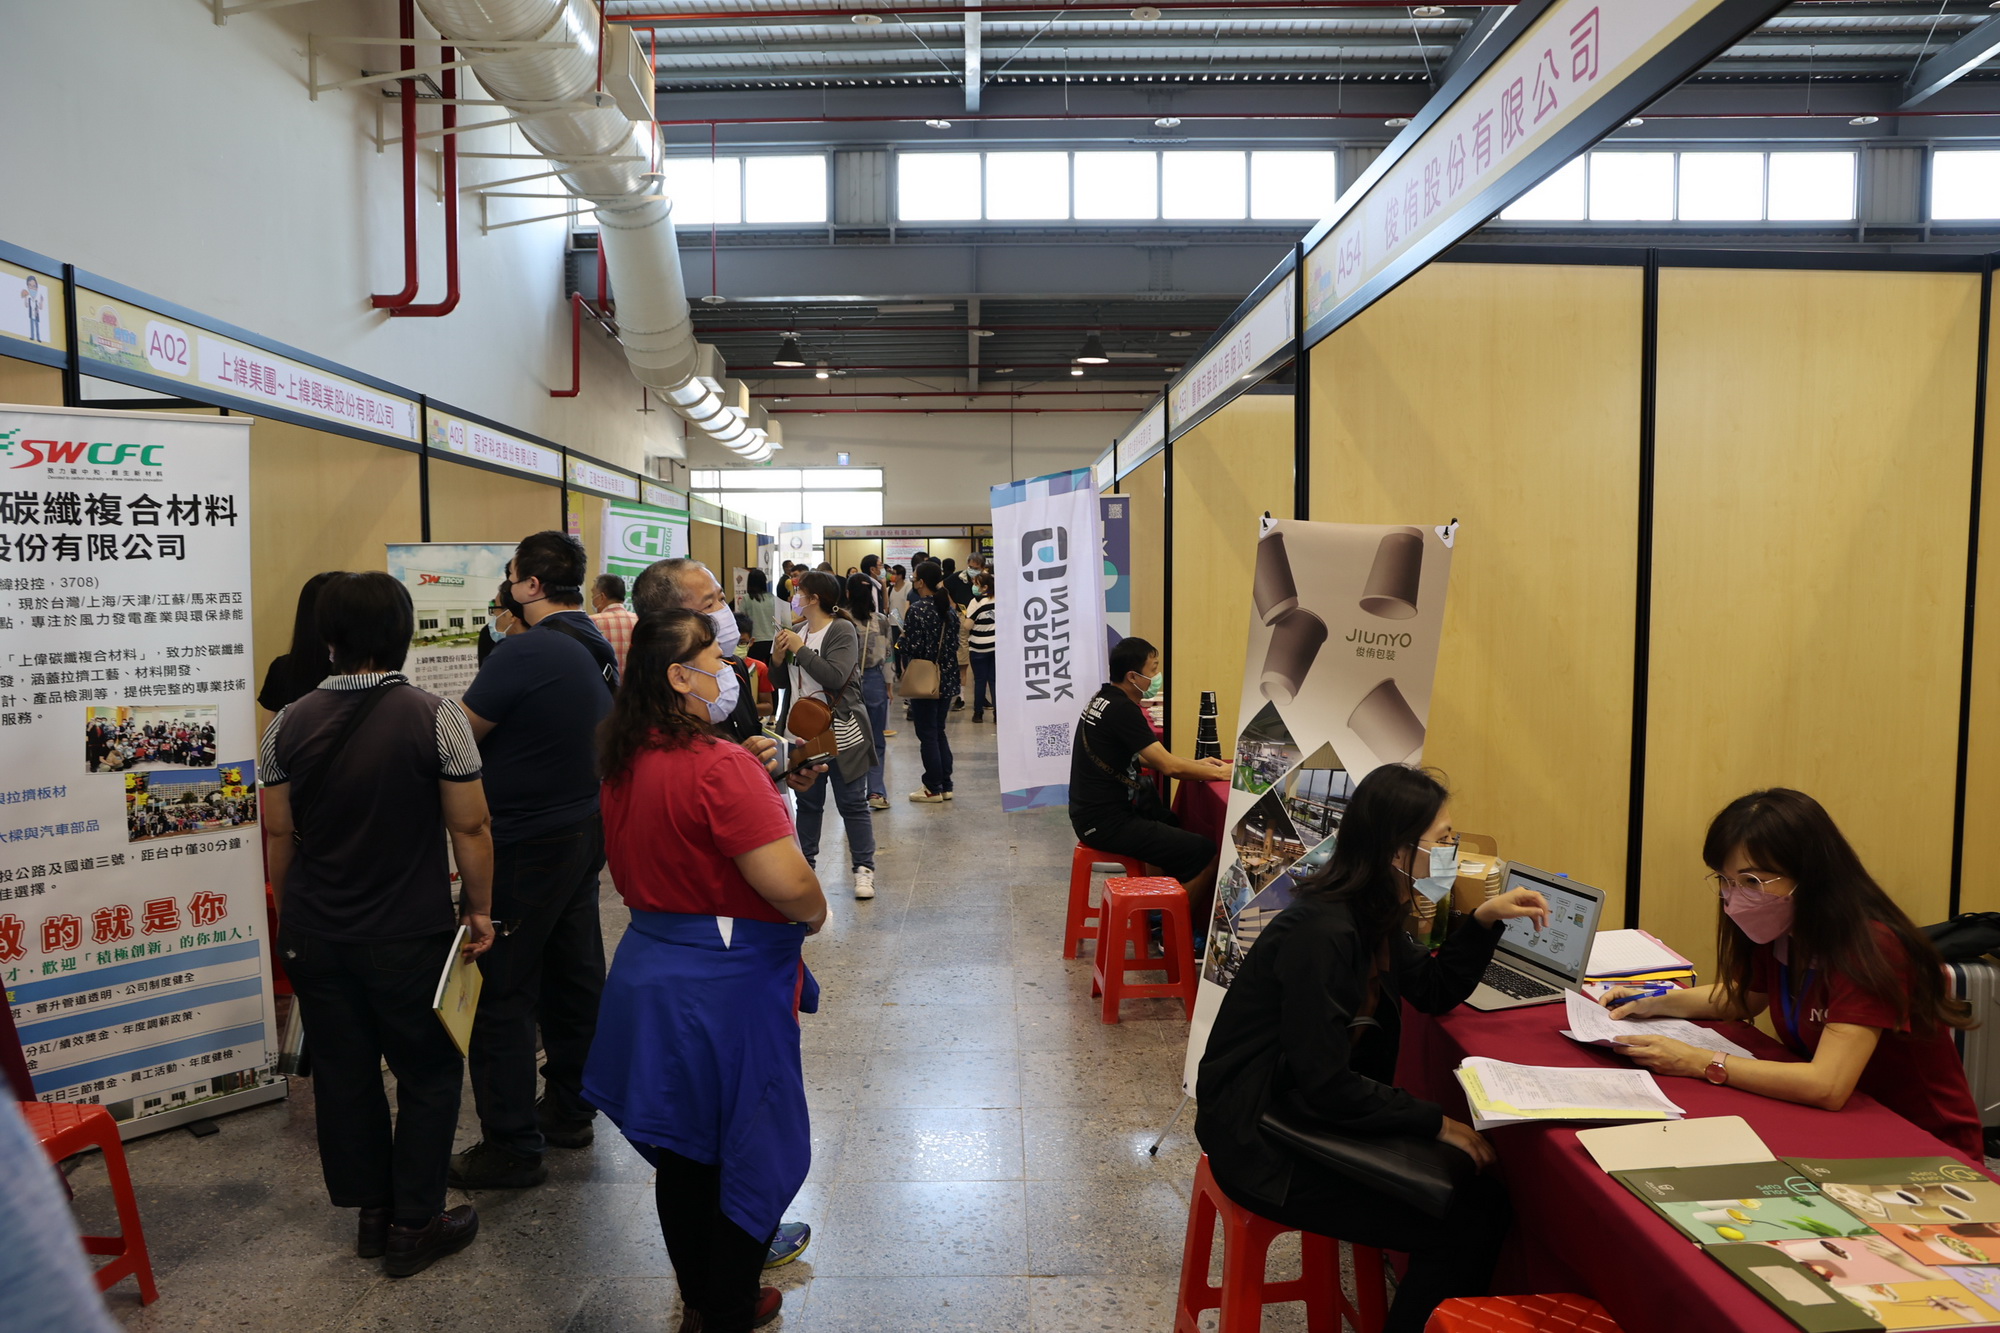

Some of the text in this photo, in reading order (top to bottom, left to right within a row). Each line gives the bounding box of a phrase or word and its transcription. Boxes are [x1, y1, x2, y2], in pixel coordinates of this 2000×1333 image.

[1384, 6, 1599, 251] 俊侑股份有限公司
[1337, 229, 1362, 284] A54
[150, 330, 187, 365] A02
[449, 425, 464, 445] A03
[10, 440, 164, 469] SWCFC
[0, 491, 237, 527] 碳纖複合材料
[664, 527, 673, 558] BIOTECH
[1356, 646, 1396, 661] 俊侑包裝
[1755, 1183, 1781, 1191] CUPS
[1762, 1187, 1788, 1195] COLD
